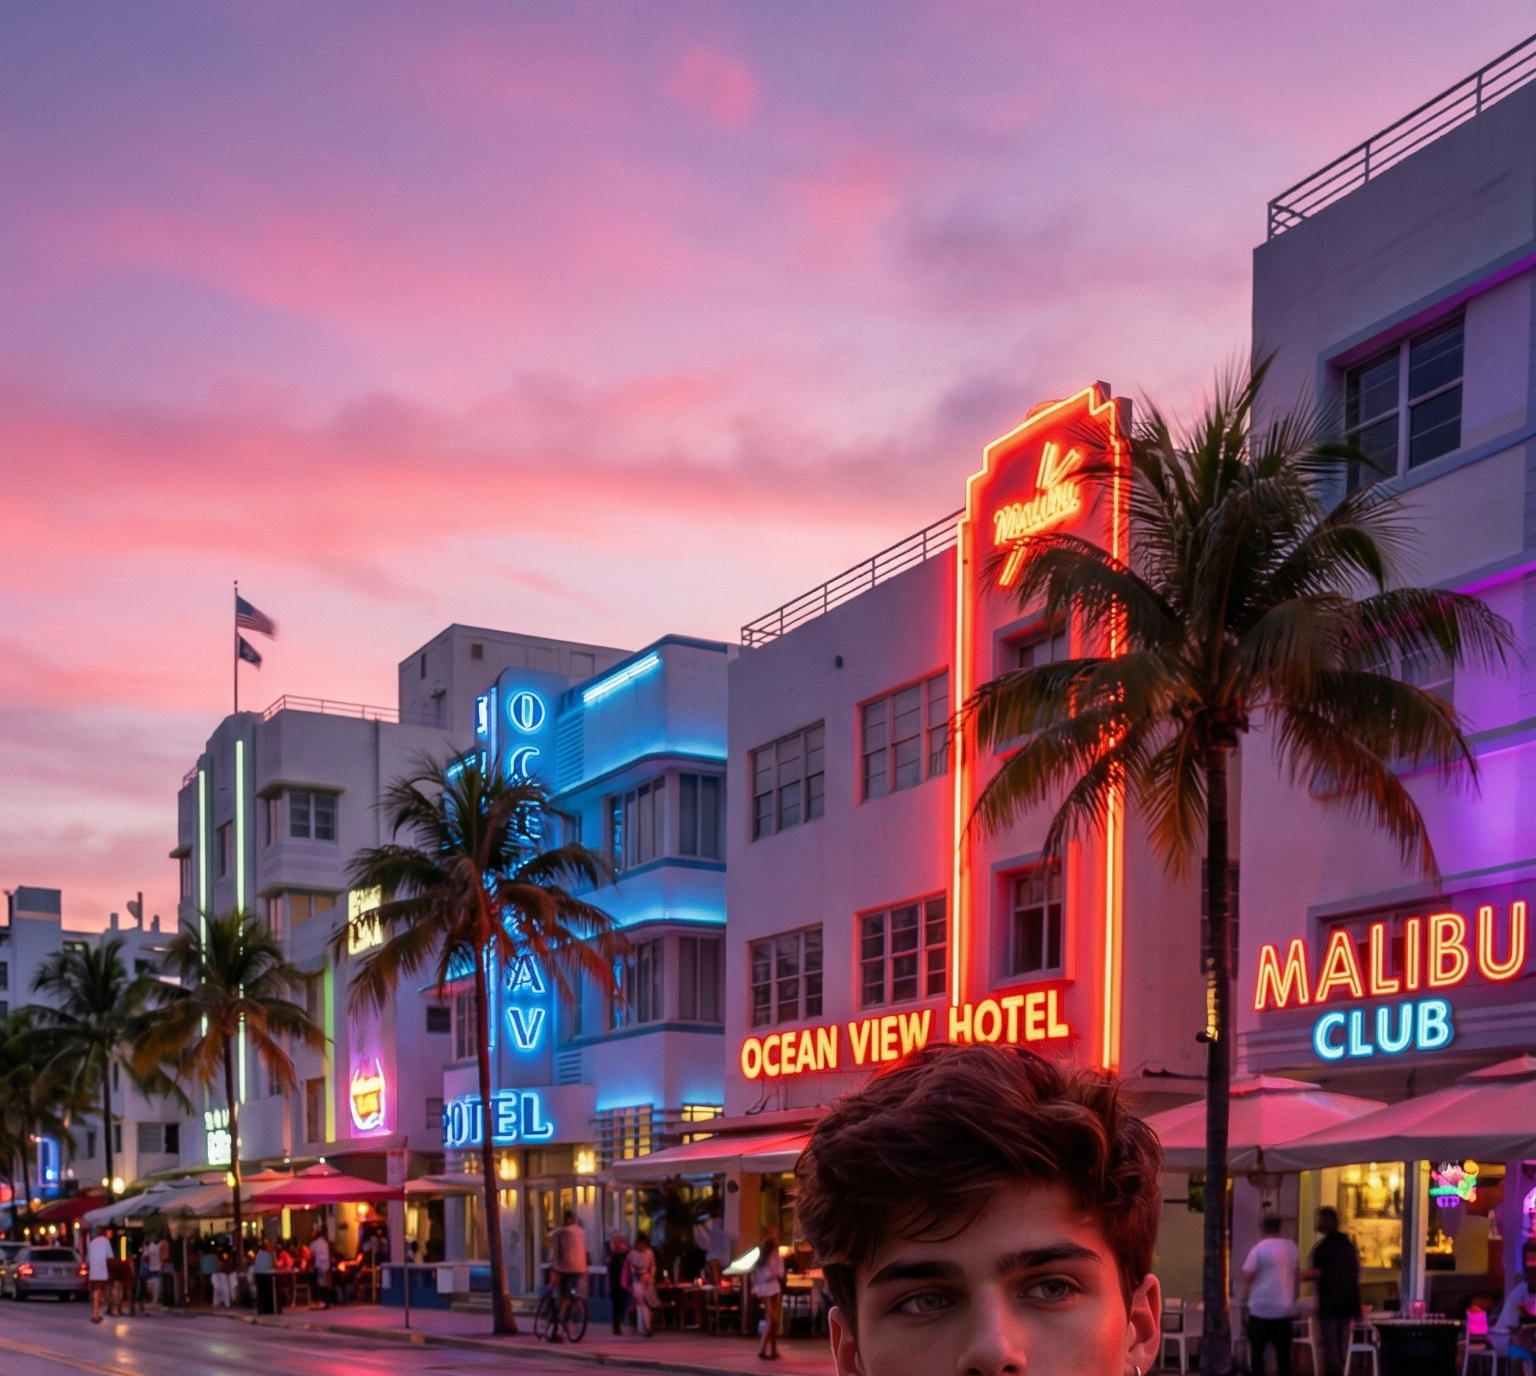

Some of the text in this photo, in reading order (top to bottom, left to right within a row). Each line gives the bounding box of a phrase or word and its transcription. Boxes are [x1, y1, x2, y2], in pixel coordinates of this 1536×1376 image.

[1254, 901, 1526, 1010] MALIBU
[741, 989, 1069, 1079] OCEAN VIEW HOTEL
[1314, 1000, 1453, 1060] CLUB
